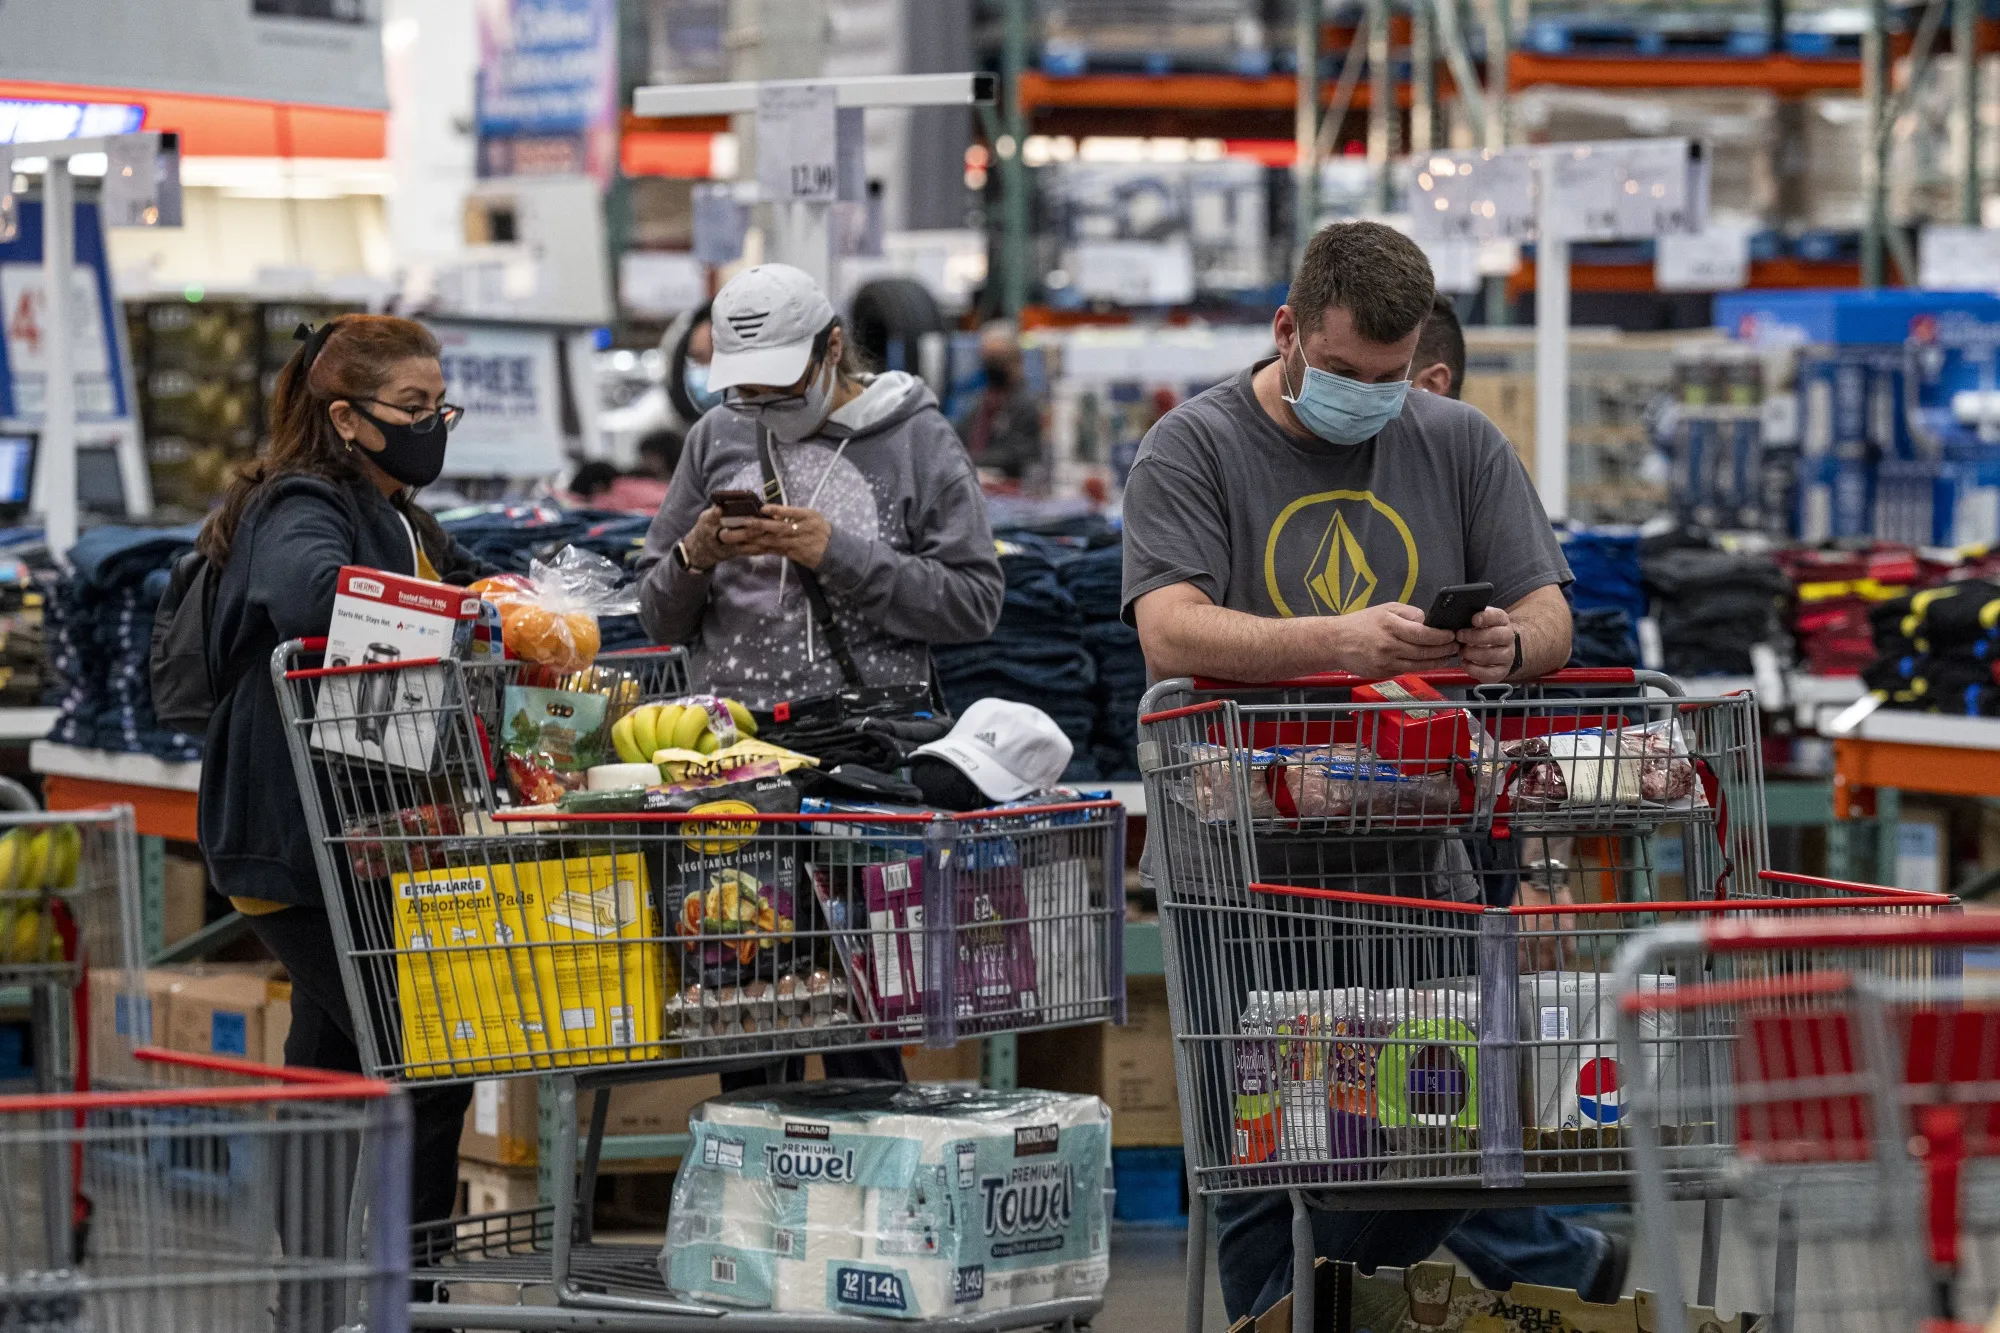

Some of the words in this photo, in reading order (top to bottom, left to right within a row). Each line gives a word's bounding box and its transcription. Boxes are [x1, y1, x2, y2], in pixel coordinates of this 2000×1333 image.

[352, 580, 380, 595] THERMOS
[418, 595, 433, 606] Since
[434, 598, 447, 610] 1904
[338, 609, 354, 618] Starts
[366, 615, 380, 625] Stays
[777, 777, 792, 789] Free
[677, 855, 733, 874] VEGETABLE
[406, 893, 491, 914] Absorbent
[497, 890, 534, 907] Pads
[786, 1123, 829, 1136] KIRKLAND
[1016, 1126, 1058, 1146] KIRKLAND
[781, 1142, 832, 1155] PREMIUM
[764, 1145, 855, 1182] Towel
[1011, 1163, 1060, 1184] PREMIUM
[980, 1163, 1072, 1233] Towel
[842, 1272, 859, 1292] 12
[1489, 1297, 1561, 1325] APPLE
